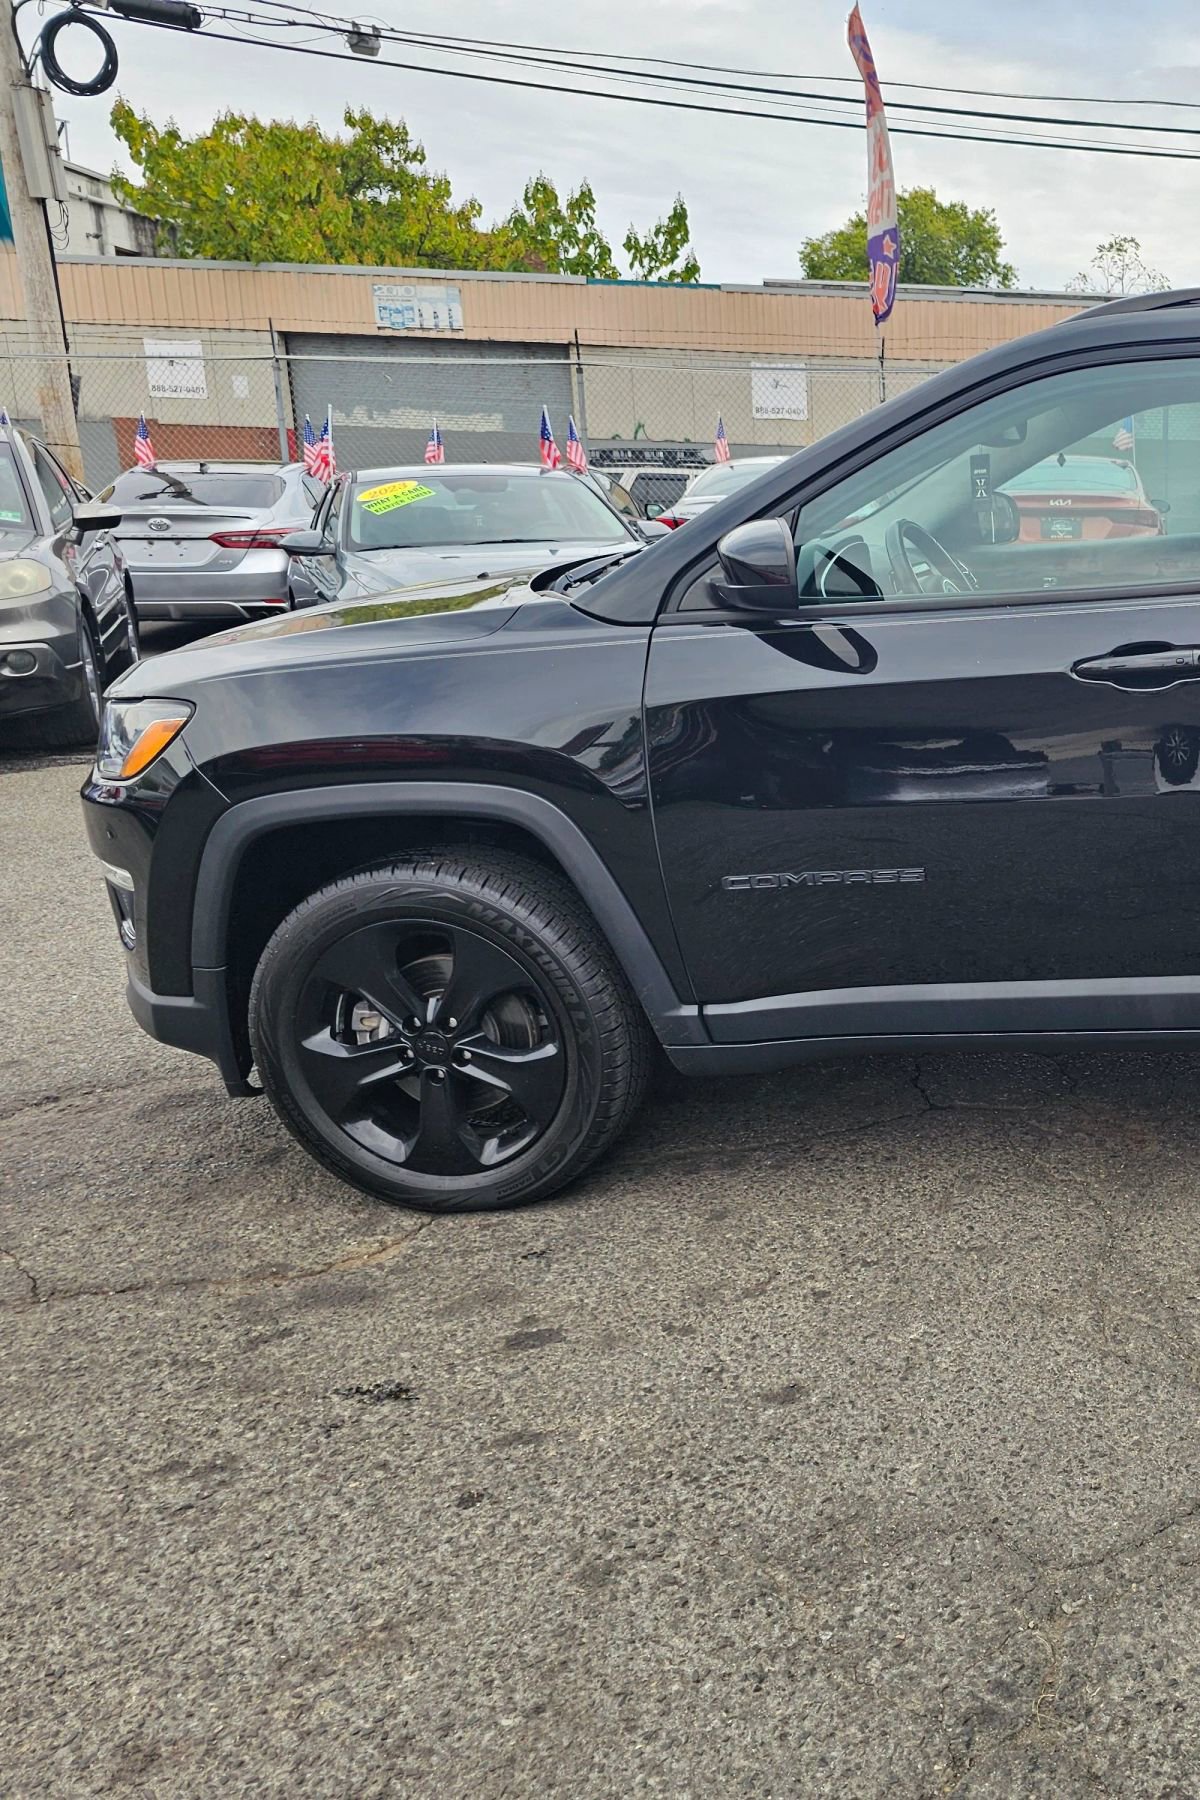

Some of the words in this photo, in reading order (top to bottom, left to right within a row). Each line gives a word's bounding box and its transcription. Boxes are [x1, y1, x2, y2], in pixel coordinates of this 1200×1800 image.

[368, 483, 408, 499] 2023
[365, 497, 391, 509] WHAT
[721, 867, 926, 890] COMPASS
[466, 901, 580, 1003] MAXTOUR
